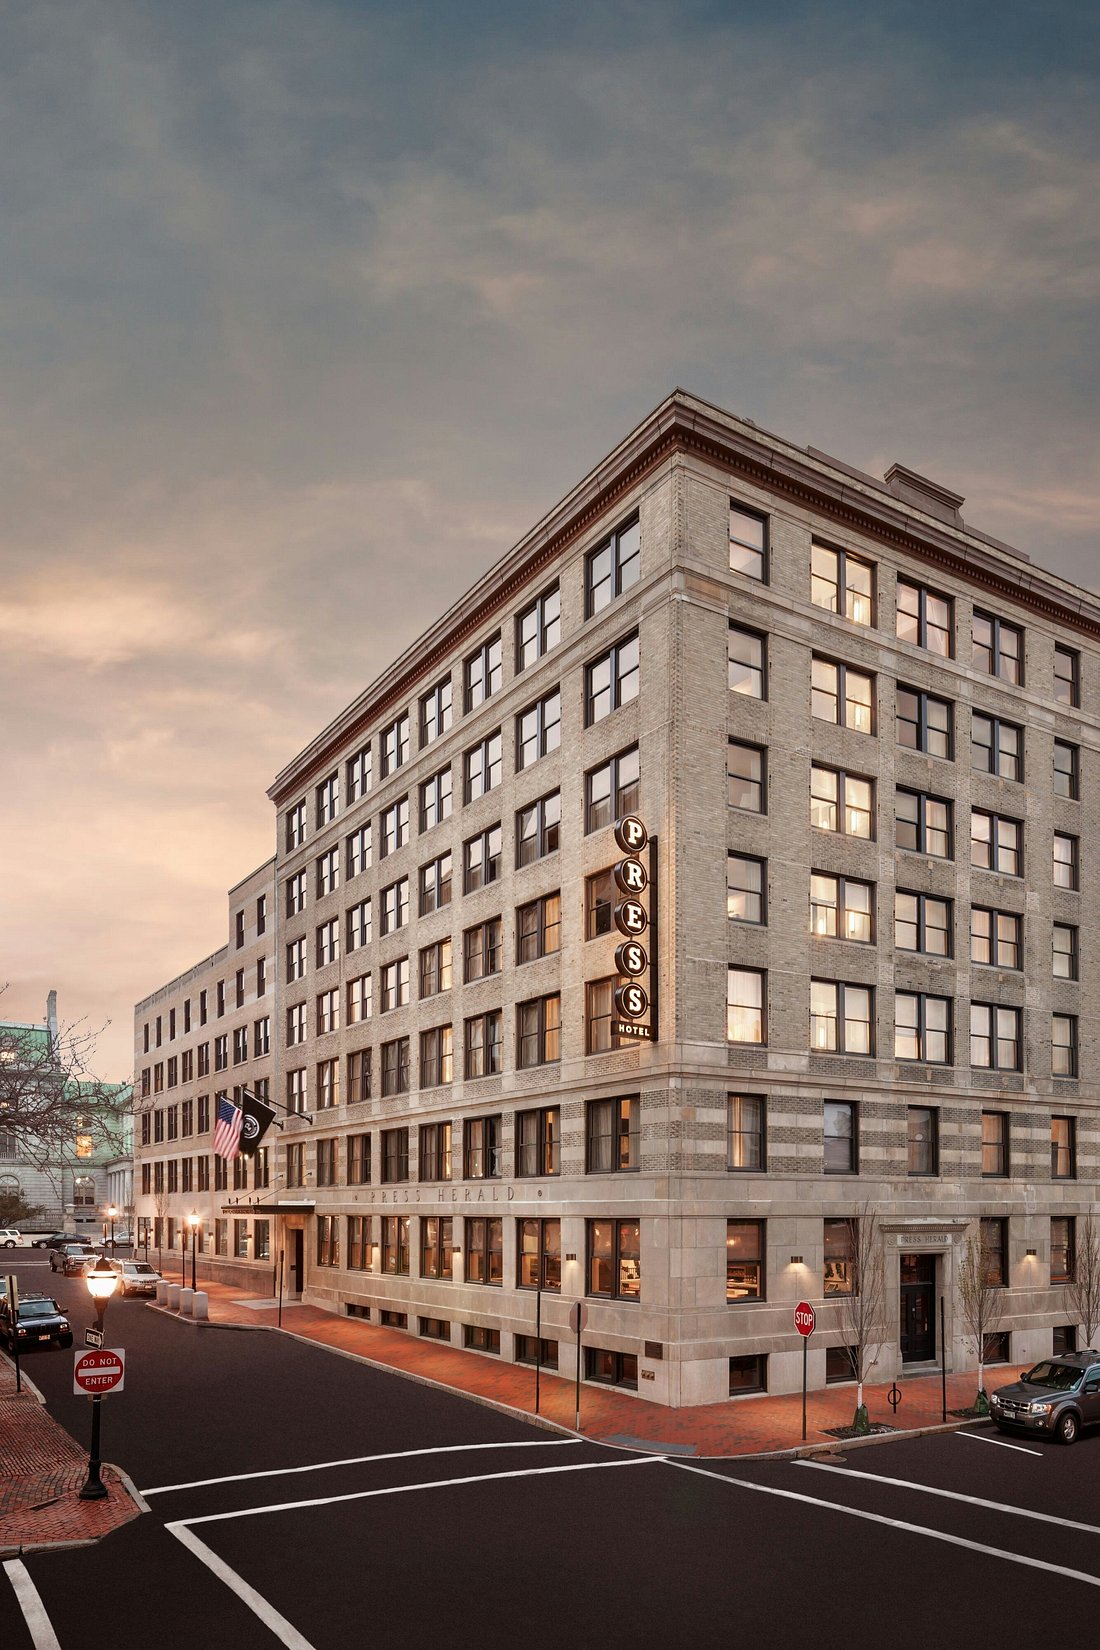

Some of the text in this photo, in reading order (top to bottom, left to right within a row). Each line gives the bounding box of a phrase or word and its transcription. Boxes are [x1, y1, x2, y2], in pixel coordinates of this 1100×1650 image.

[627, 820, 643, 1012] PRESS
[618, 1023, 650, 1037] HOTEL
[370, 1186, 515, 1203] PRESS HERALD
[901, 1235, 949, 1243] PRESS HERALD
[795, 1311, 813, 1326] STOP
[82, 1357, 117, 1367] DO NOT
[85, 1376, 113, 1386] ENTER
